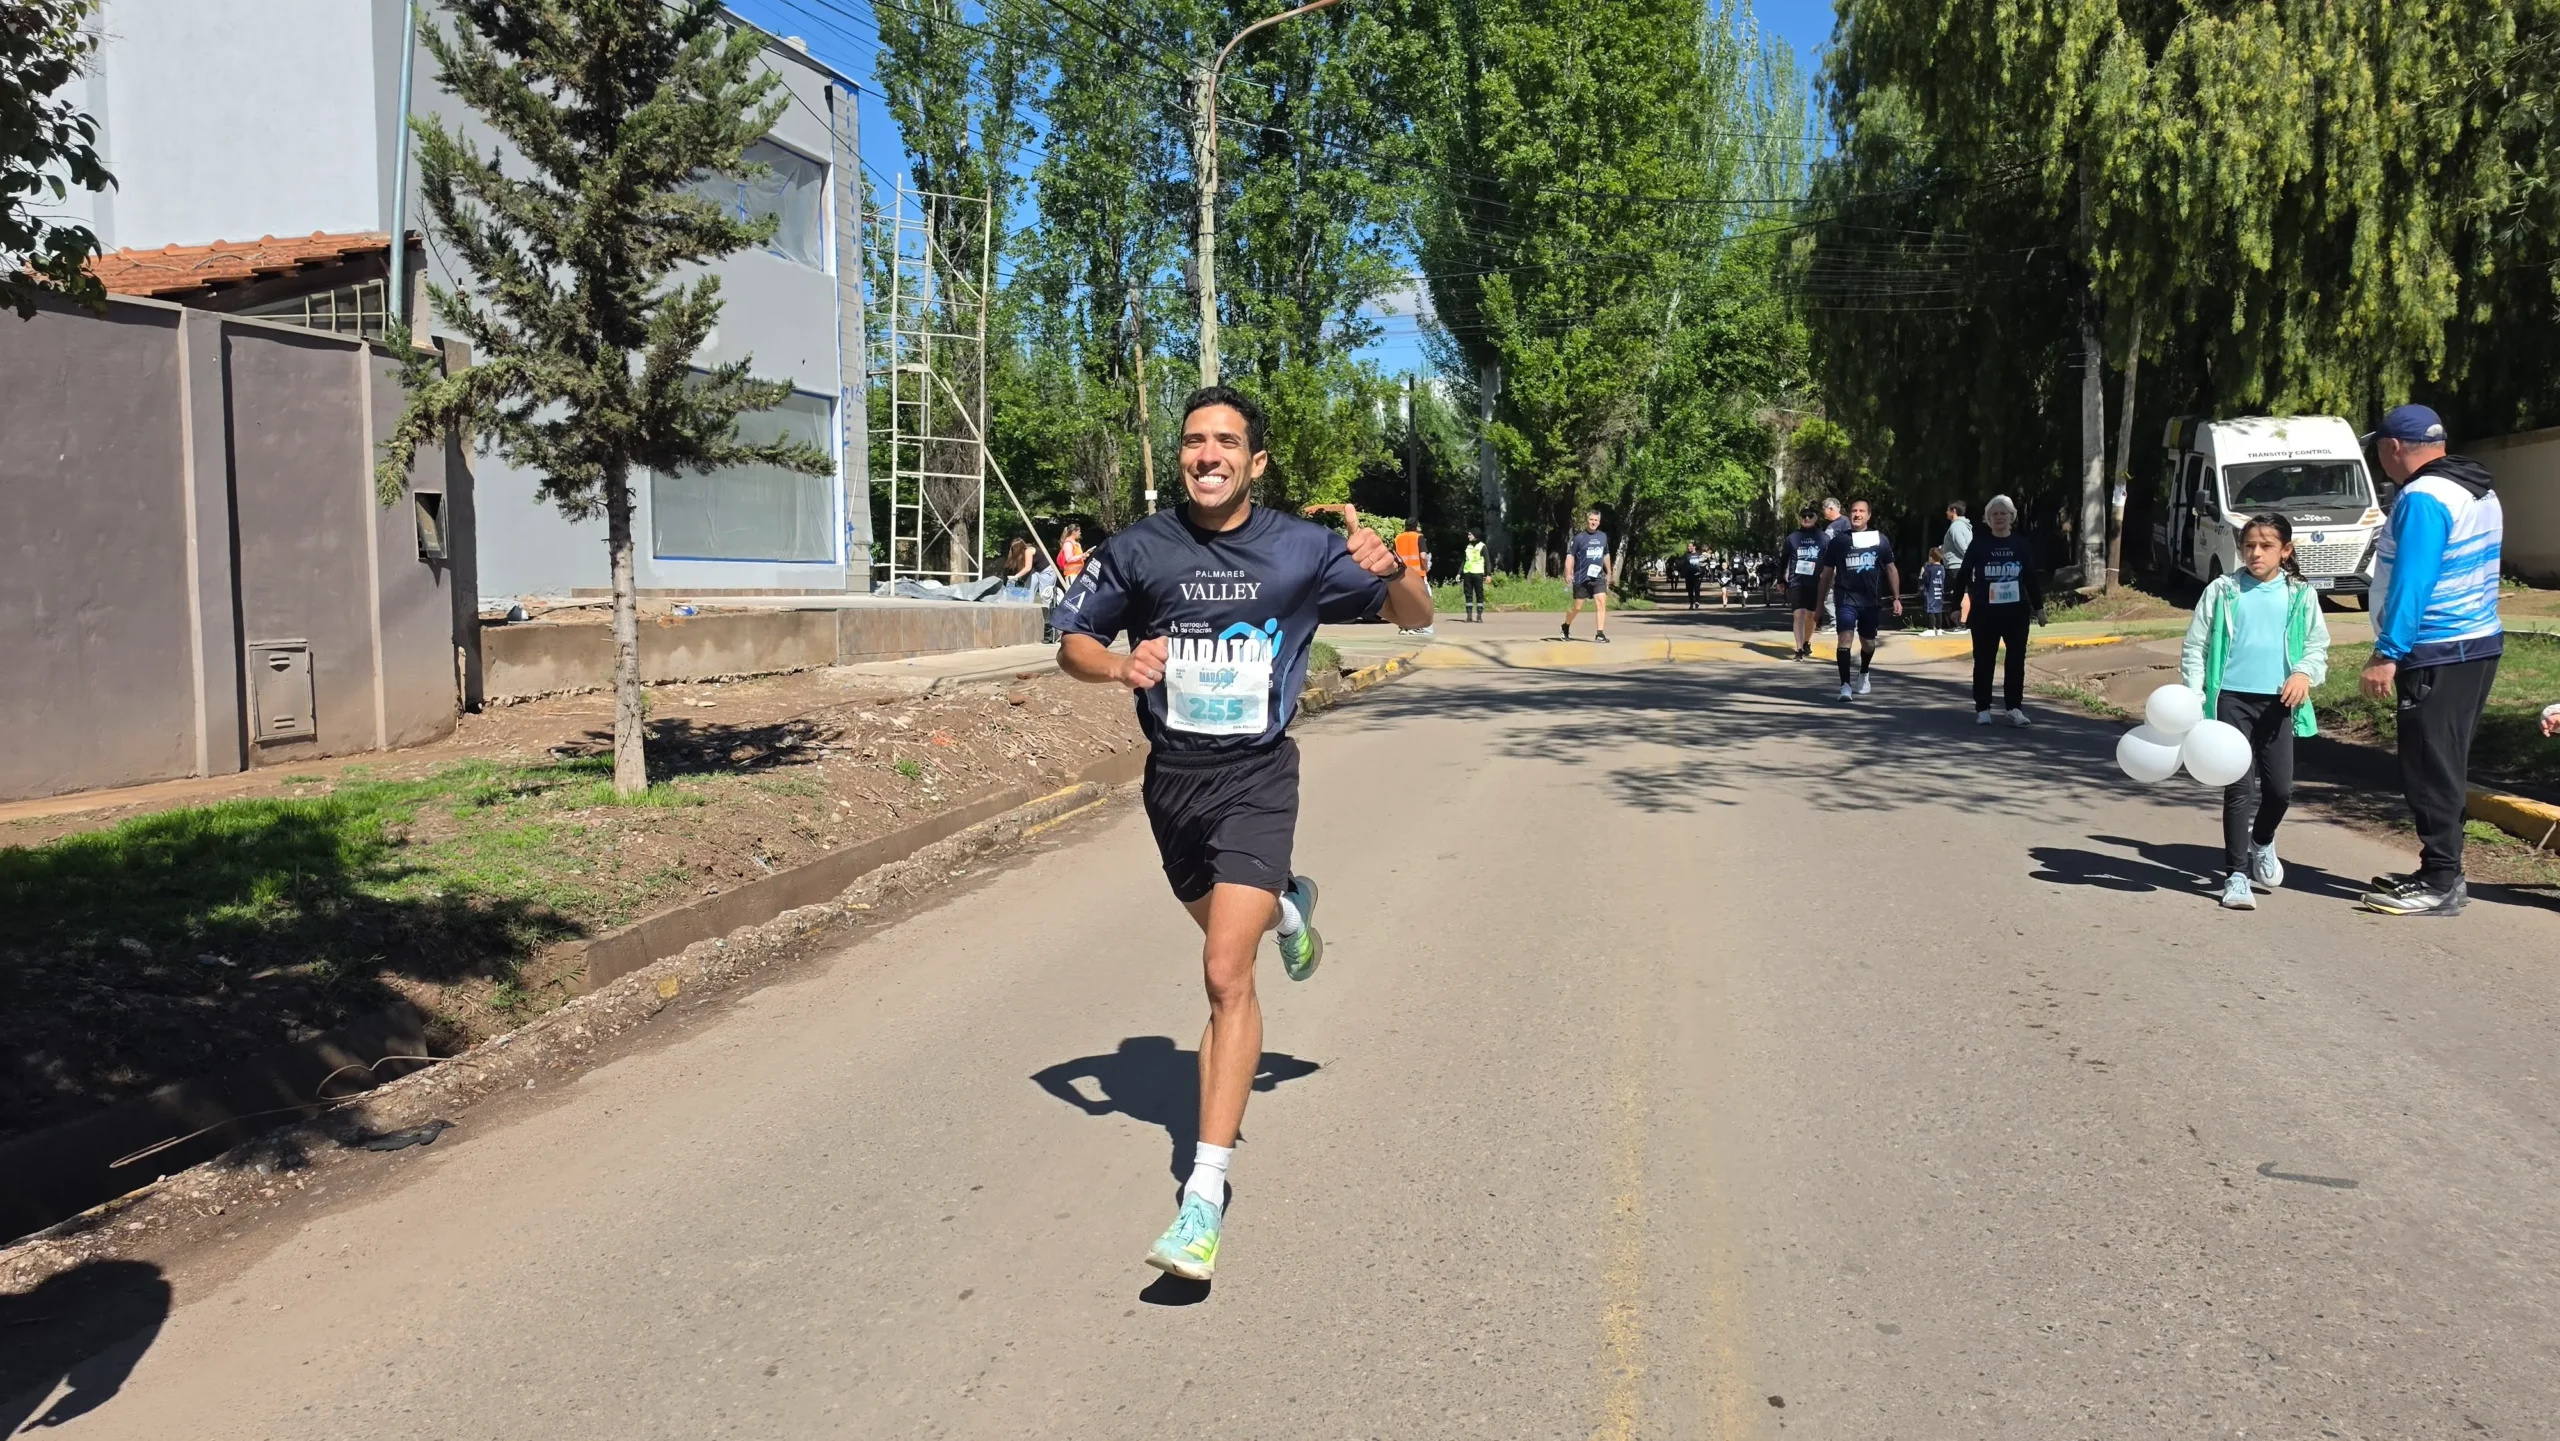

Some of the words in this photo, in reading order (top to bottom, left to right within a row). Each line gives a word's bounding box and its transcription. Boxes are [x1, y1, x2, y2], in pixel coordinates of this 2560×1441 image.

[1195, 570, 1245, 578] PALMARES
[1180, 582, 1261, 600] VALLEY
[1188, 697, 1244, 721] 255
